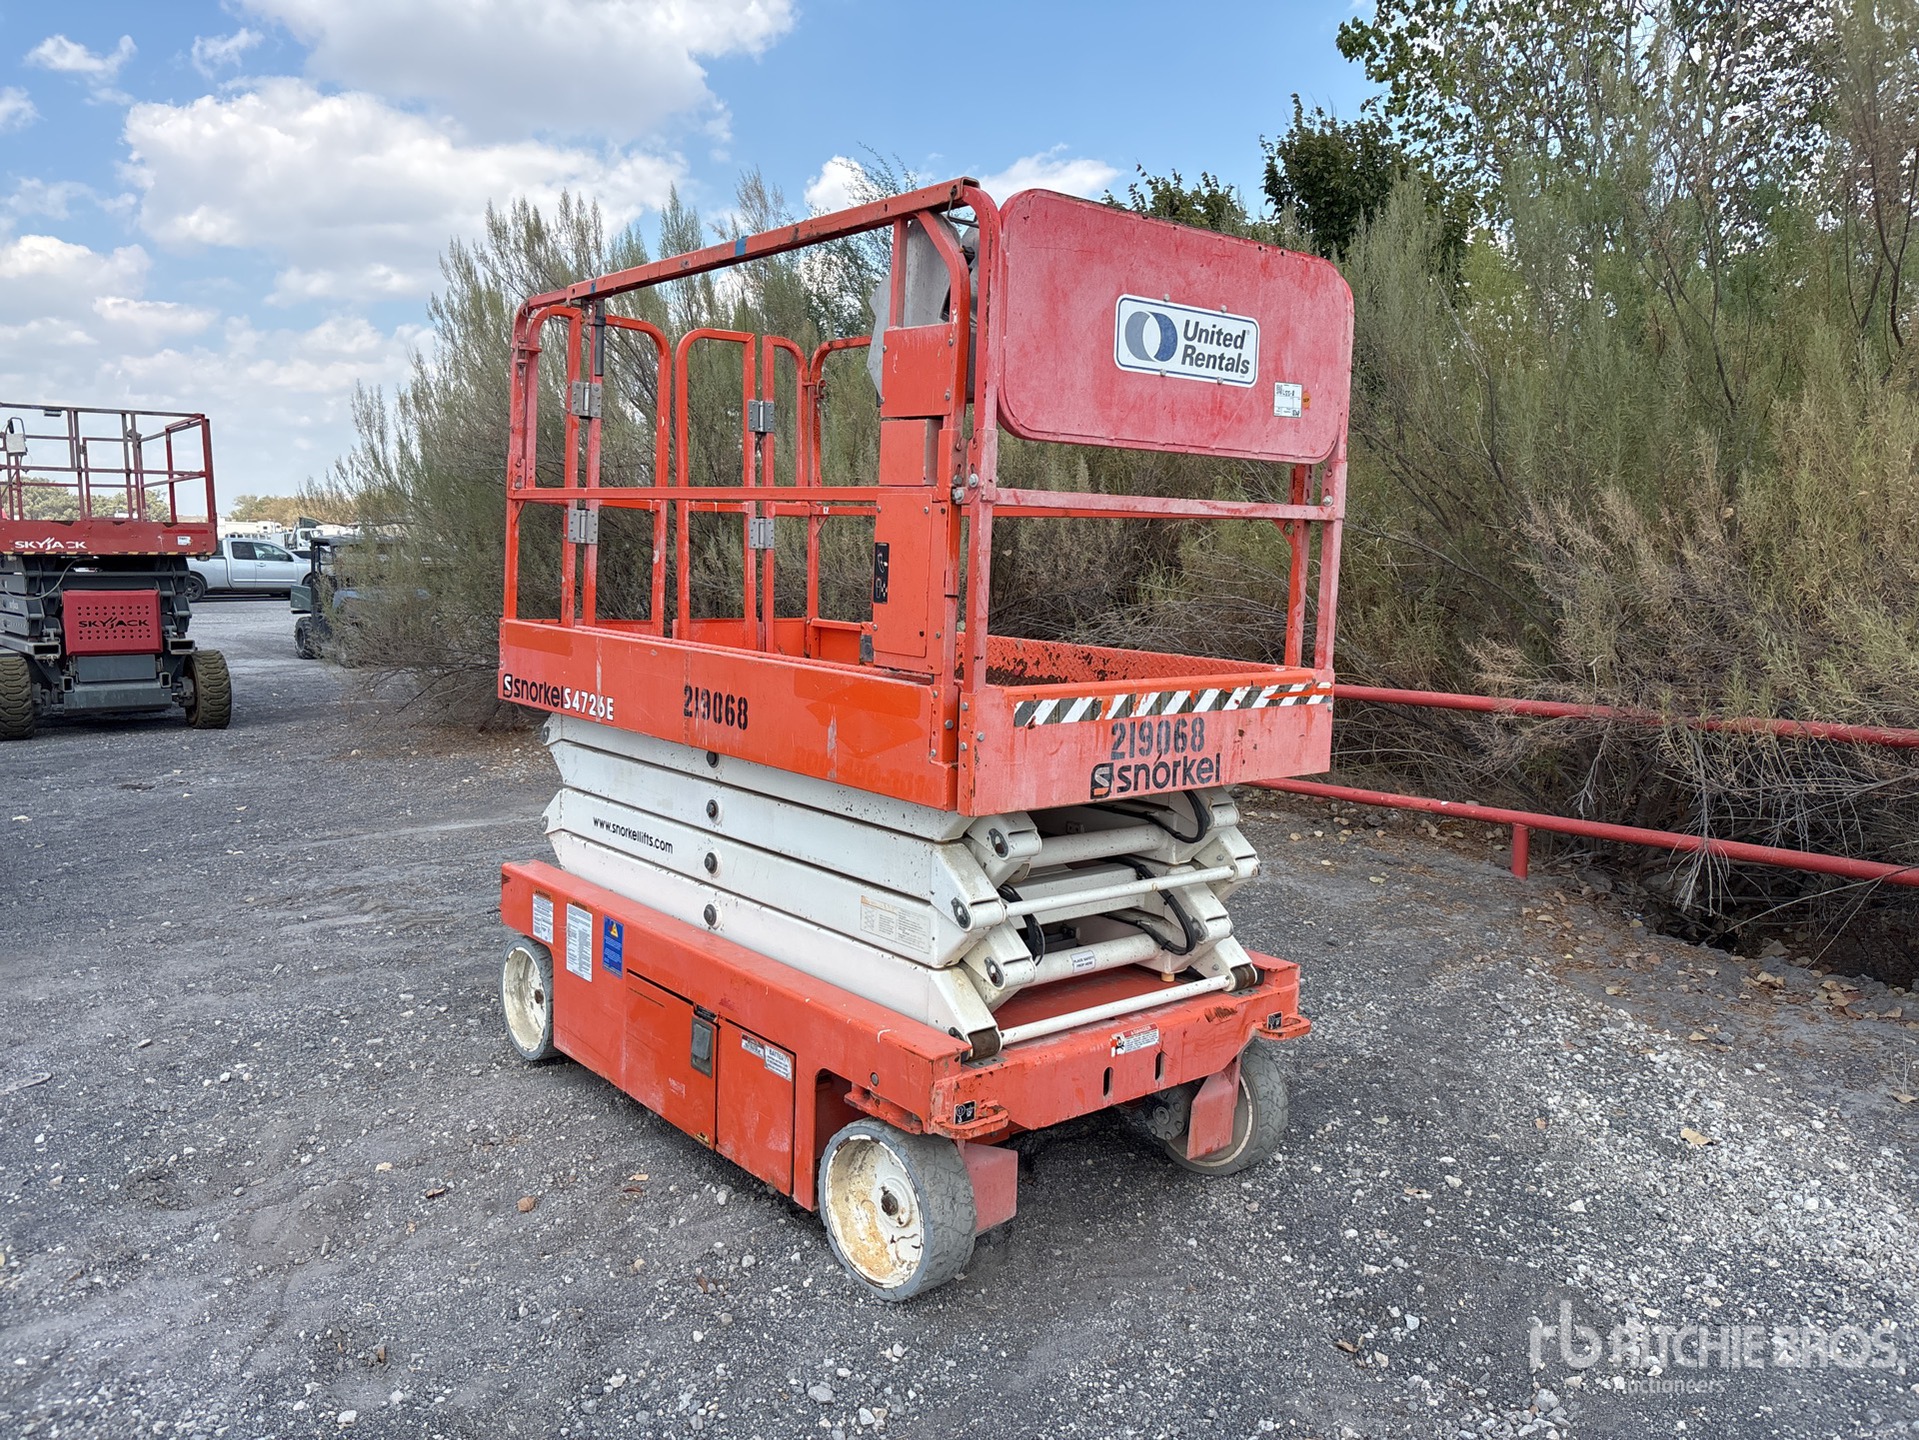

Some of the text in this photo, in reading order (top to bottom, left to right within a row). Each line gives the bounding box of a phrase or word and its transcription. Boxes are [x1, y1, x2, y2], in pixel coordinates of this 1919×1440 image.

[1183, 319, 1246, 350] United
[1181, 344, 1250, 375] Rentals
[79, 617, 149, 630] SKYJACK
[514, 678, 564, 708] snorkel
[564, 687, 614, 722] S4726E
[684, 685, 748, 730] 219068
[1111, 717, 1205, 761] 219068
[1116, 752, 1221, 794] snorkel
[592, 816, 674, 855] www.snorkellifts.com
